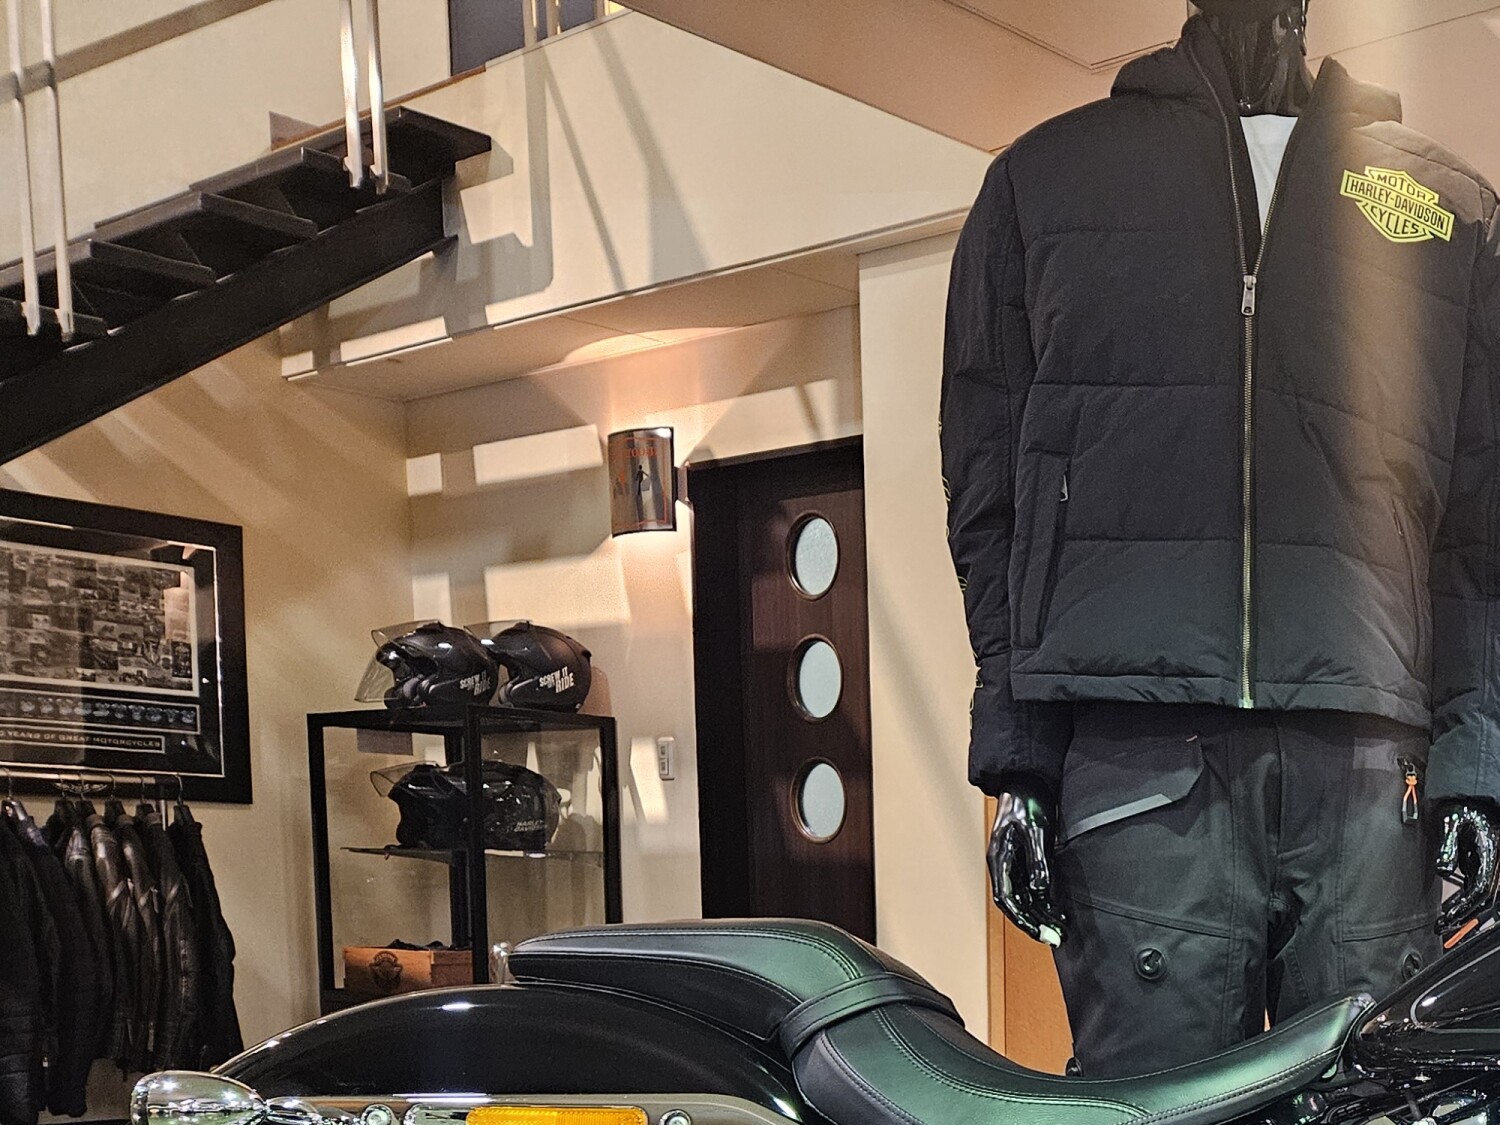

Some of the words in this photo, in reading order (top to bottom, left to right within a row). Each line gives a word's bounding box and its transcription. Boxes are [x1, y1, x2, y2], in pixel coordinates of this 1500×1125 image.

[1377, 174, 1426, 201] MOTOR
[1350, 179, 1445, 231] HARLEY-DAVIDSON
[1370, 205, 1420, 235] CYCLES
[555, 672, 575, 693] RIDE
